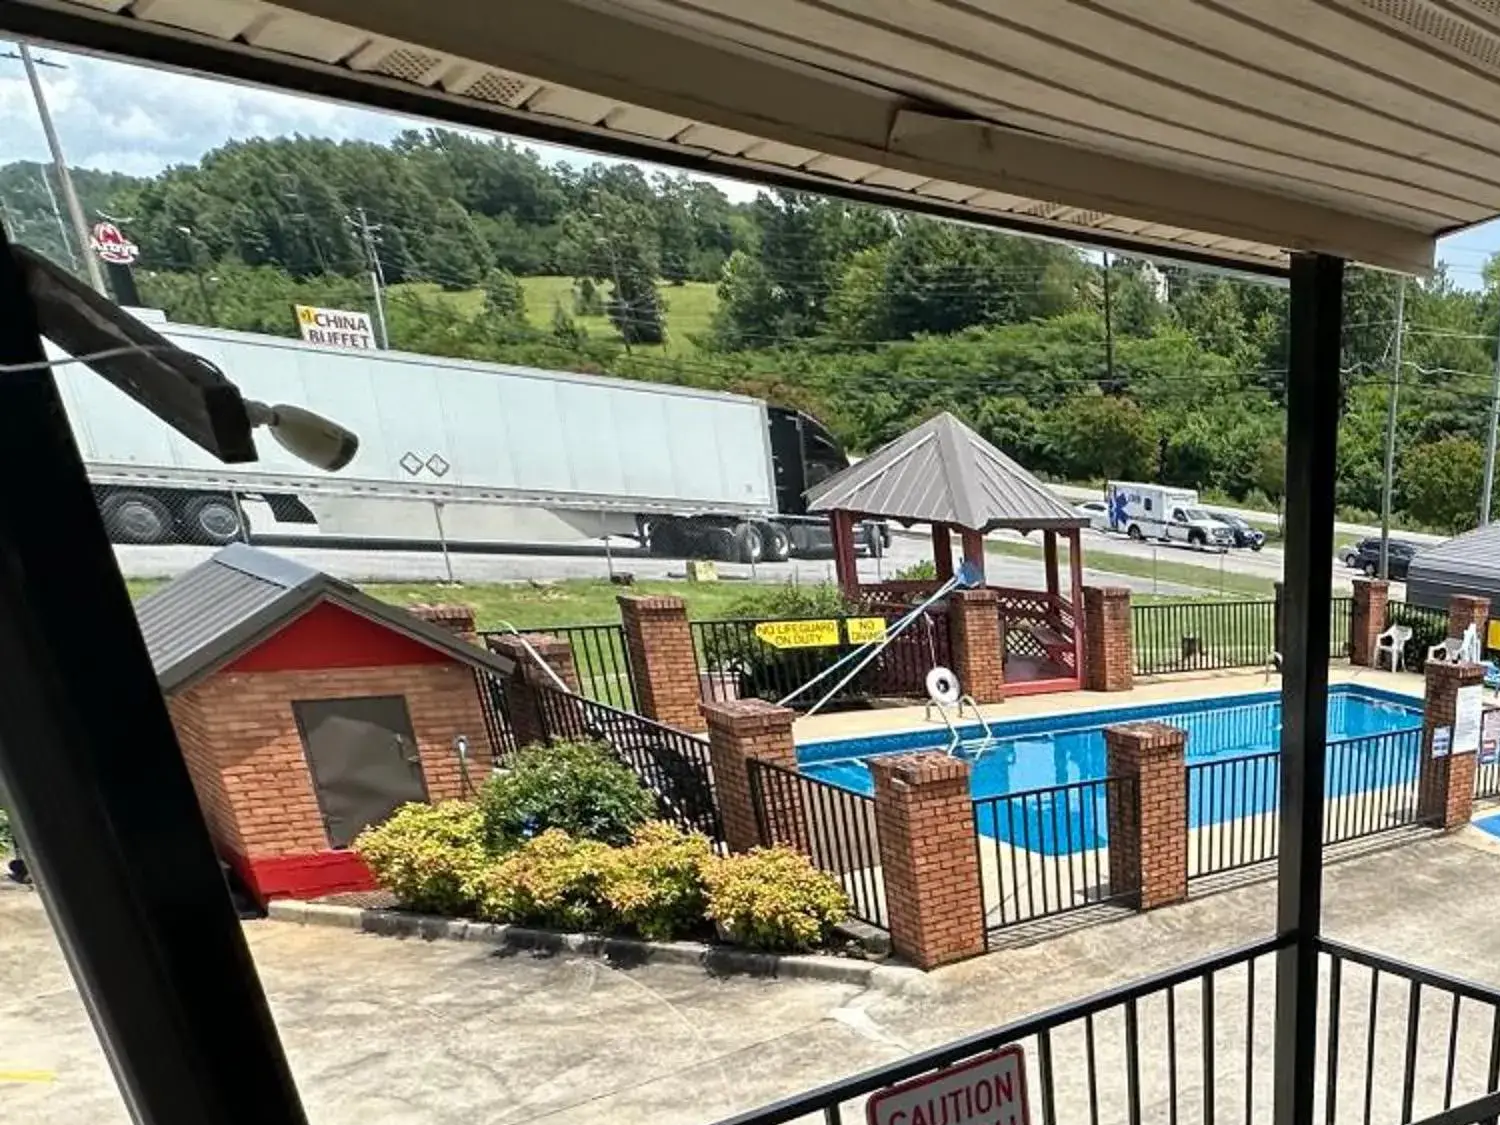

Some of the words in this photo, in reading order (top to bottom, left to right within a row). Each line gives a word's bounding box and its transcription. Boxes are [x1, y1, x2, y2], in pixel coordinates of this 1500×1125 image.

[314, 313, 369, 331] CHINA
[309, 329, 370, 349] BUFFET
[757, 623, 775, 635] NO
[776, 621, 835, 633] LIFEGUARD
[775, 635, 791, 645] ON
[794, 633, 823, 645] DUTY
